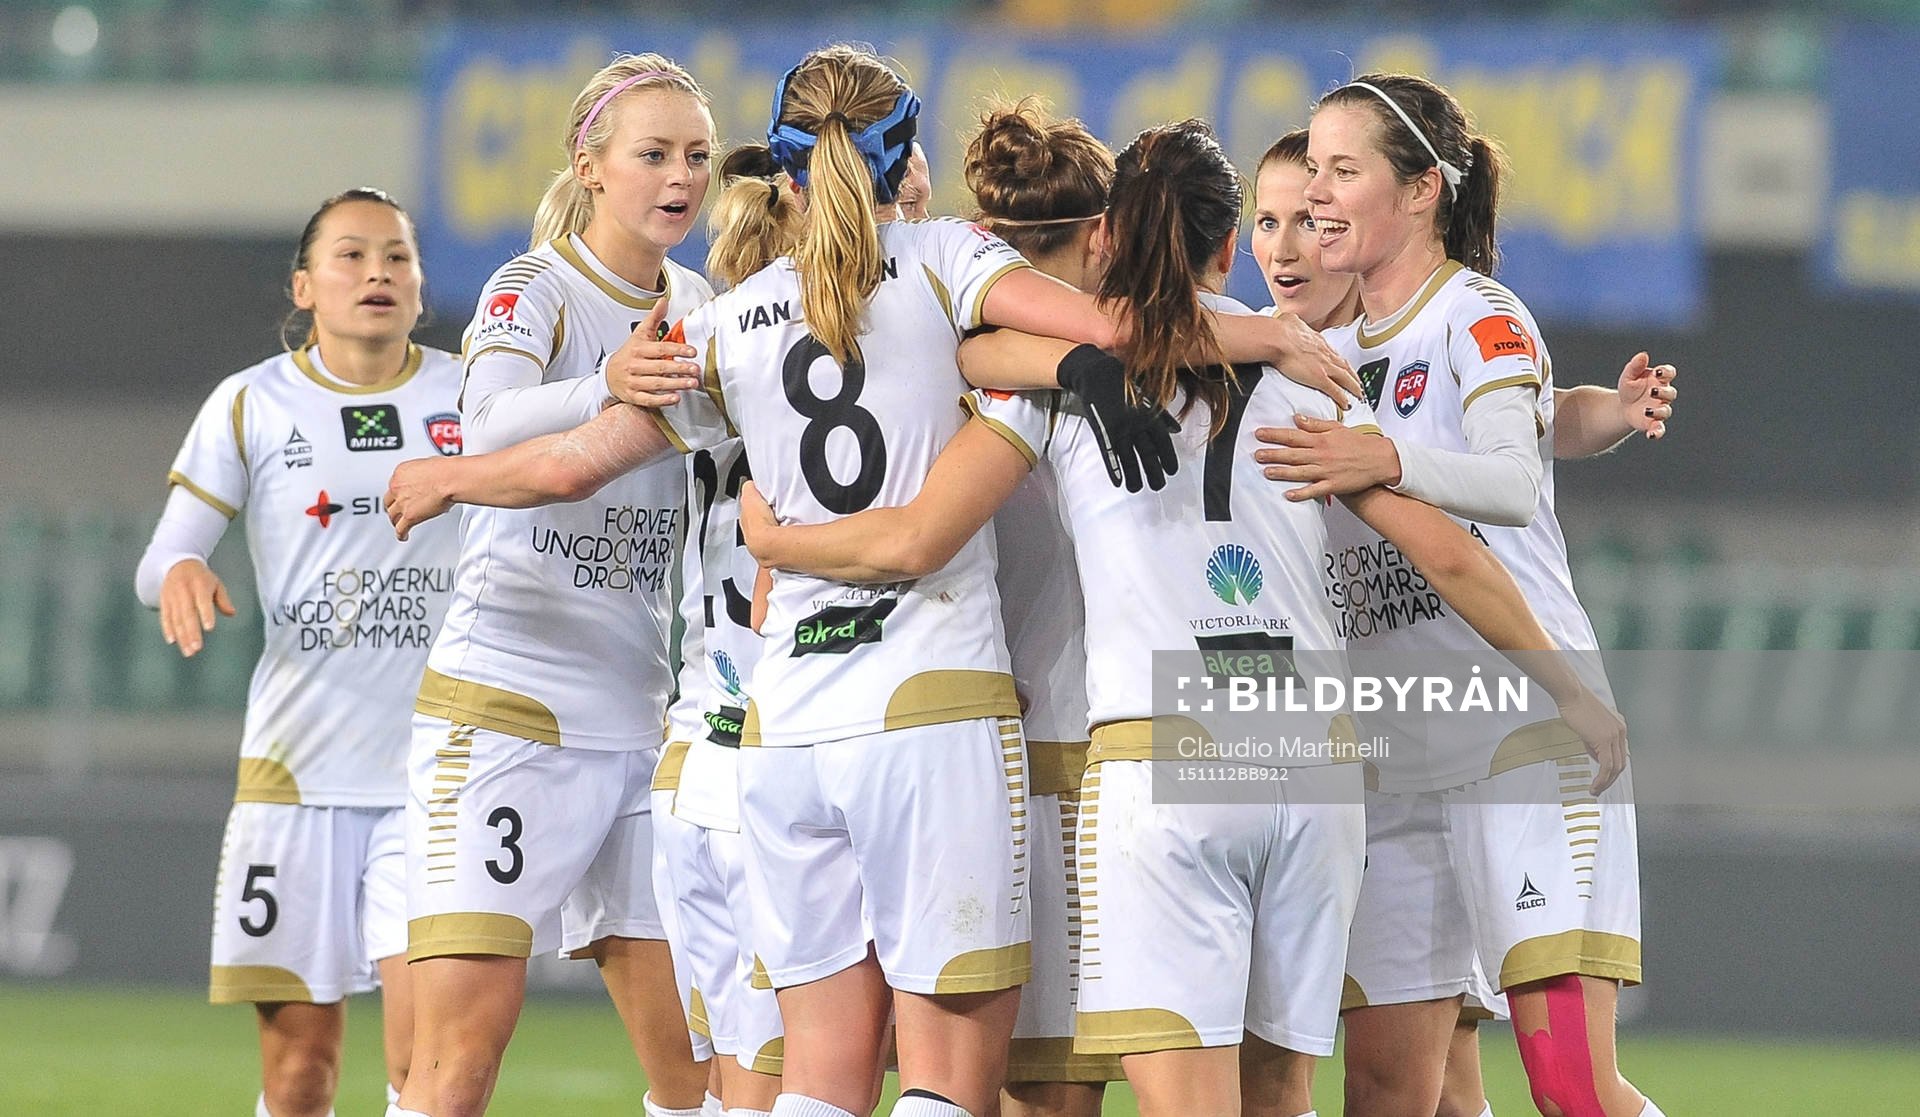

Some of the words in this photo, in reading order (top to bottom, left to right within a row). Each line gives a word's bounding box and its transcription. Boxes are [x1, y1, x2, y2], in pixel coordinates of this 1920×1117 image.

[738, 300, 791, 333] VAN
[507, 323, 533, 337] SPEL
[1398, 375, 1425, 392] FCR
[782, 333, 887, 515] 8
[350, 436, 398, 448] MIKZ
[352, 497, 386, 515] SI
[323, 567, 456, 597] FÖRVERKLI
[1206, 651, 1275, 676] akea
[485, 806, 524, 884] 3
[239, 865, 277, 937] 5
[1516, 898, 1546, 911] SELECT
